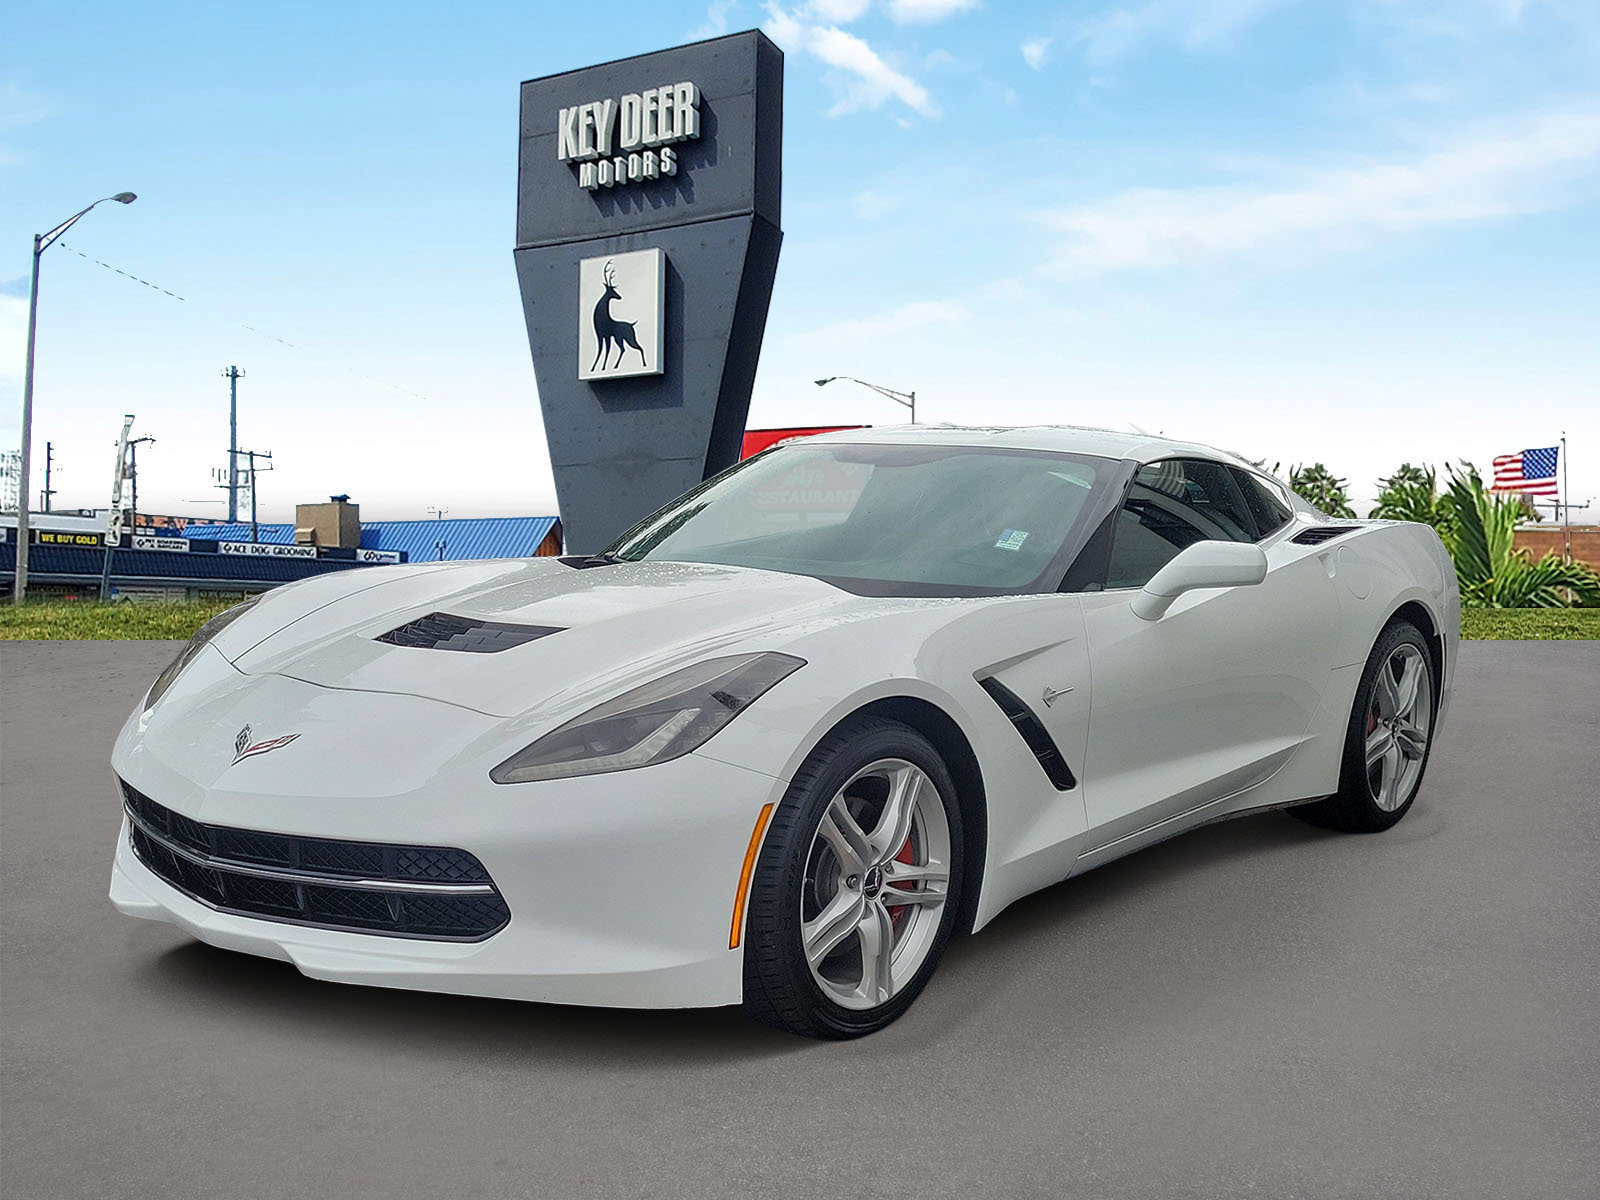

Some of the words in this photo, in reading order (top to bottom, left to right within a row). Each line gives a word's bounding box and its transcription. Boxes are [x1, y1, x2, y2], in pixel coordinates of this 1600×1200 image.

[558, 98, 617, 162] KEY
[620, 81, 699, 151] DEER
[579, 147, 677, 190] MOTORS
[41, 533, 55, 543] WE
[57, 534, 74, 544] BUY
[76, 535, 98, 545] GOLD
[232, 544, 247, 553] ACE
[251, 545, 270, 555] DOG
[272, 546, 315, 557] GROOMING
